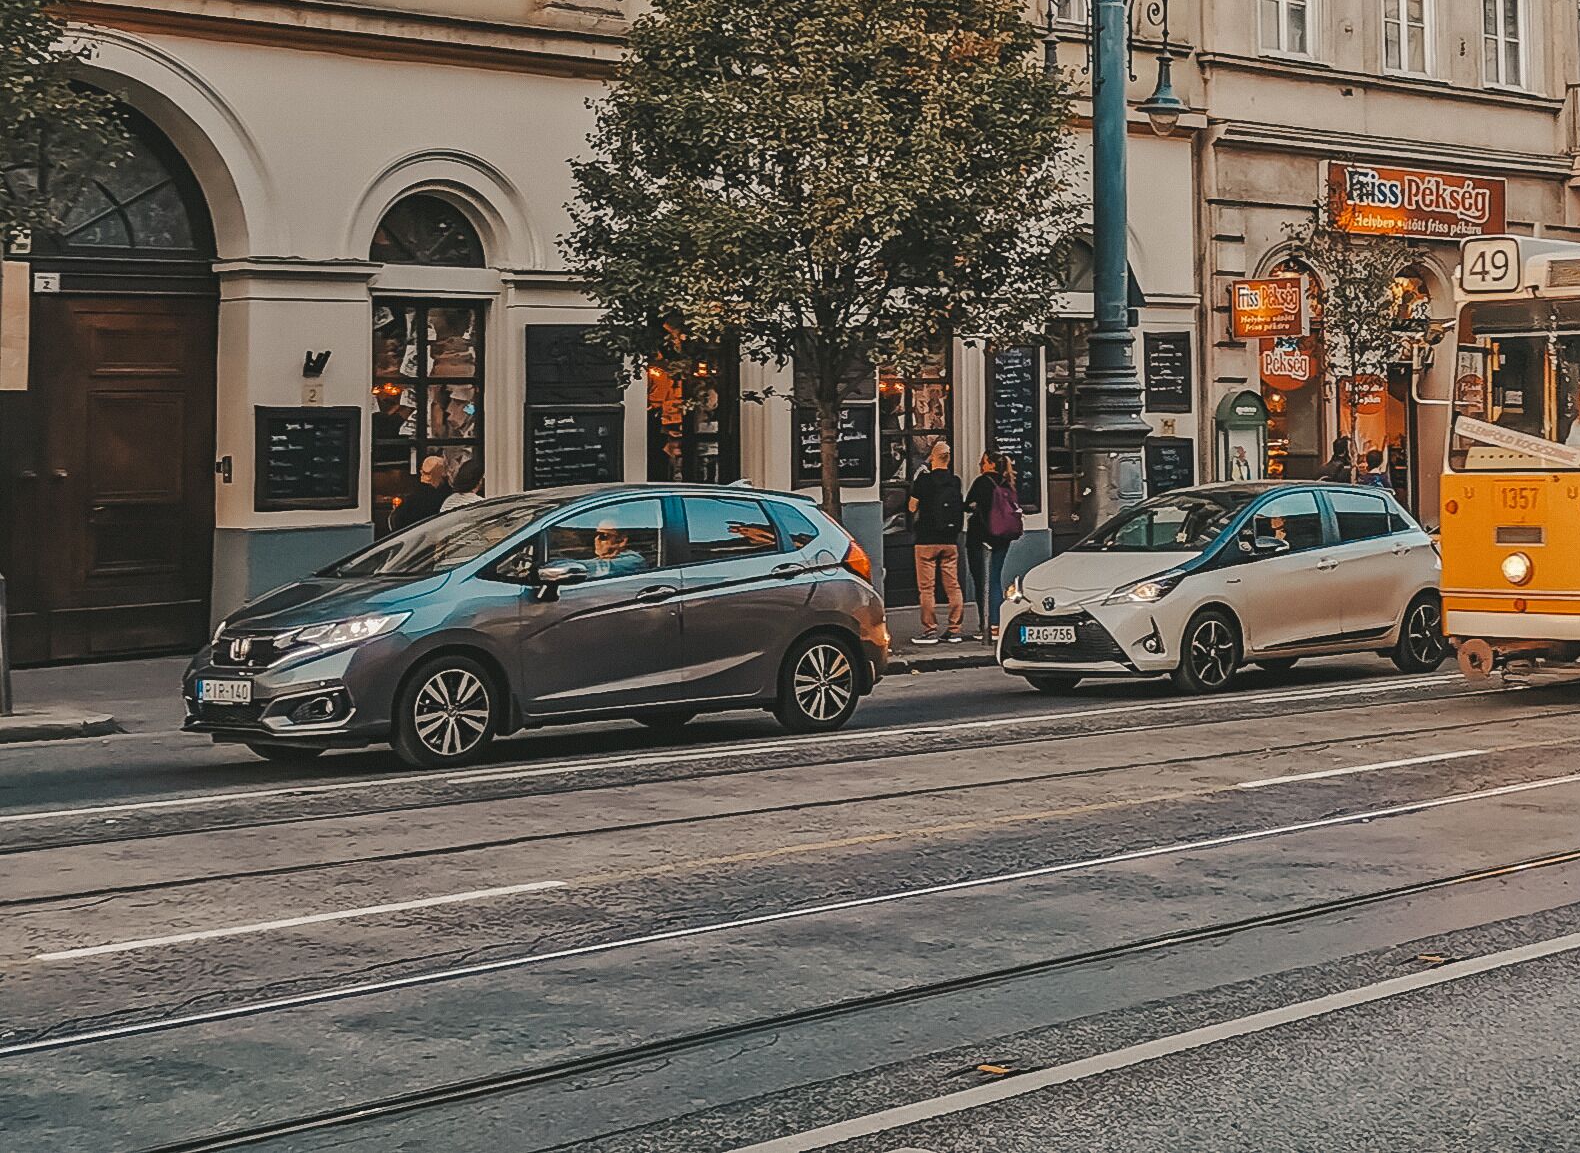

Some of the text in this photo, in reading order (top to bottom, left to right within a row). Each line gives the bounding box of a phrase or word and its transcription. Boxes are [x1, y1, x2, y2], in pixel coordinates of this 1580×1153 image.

[1345, 167, 1490, 223] Friss Pékség
[1354, 213, 1395, 229] Helyben
[1427, 219, 1448, 234] friss
[1468, 249, 1509, 282] 49
[1260, 283, 1299, 313] Pékség
[1263, 350, 1309, 380] Pékség
[308, 388, 317, 403] 2
[1501, 487, 1538, 509] 1357
[1027, 628, 1073, 641] RAG-756
[205, 682, 248, 700] RIR-140
